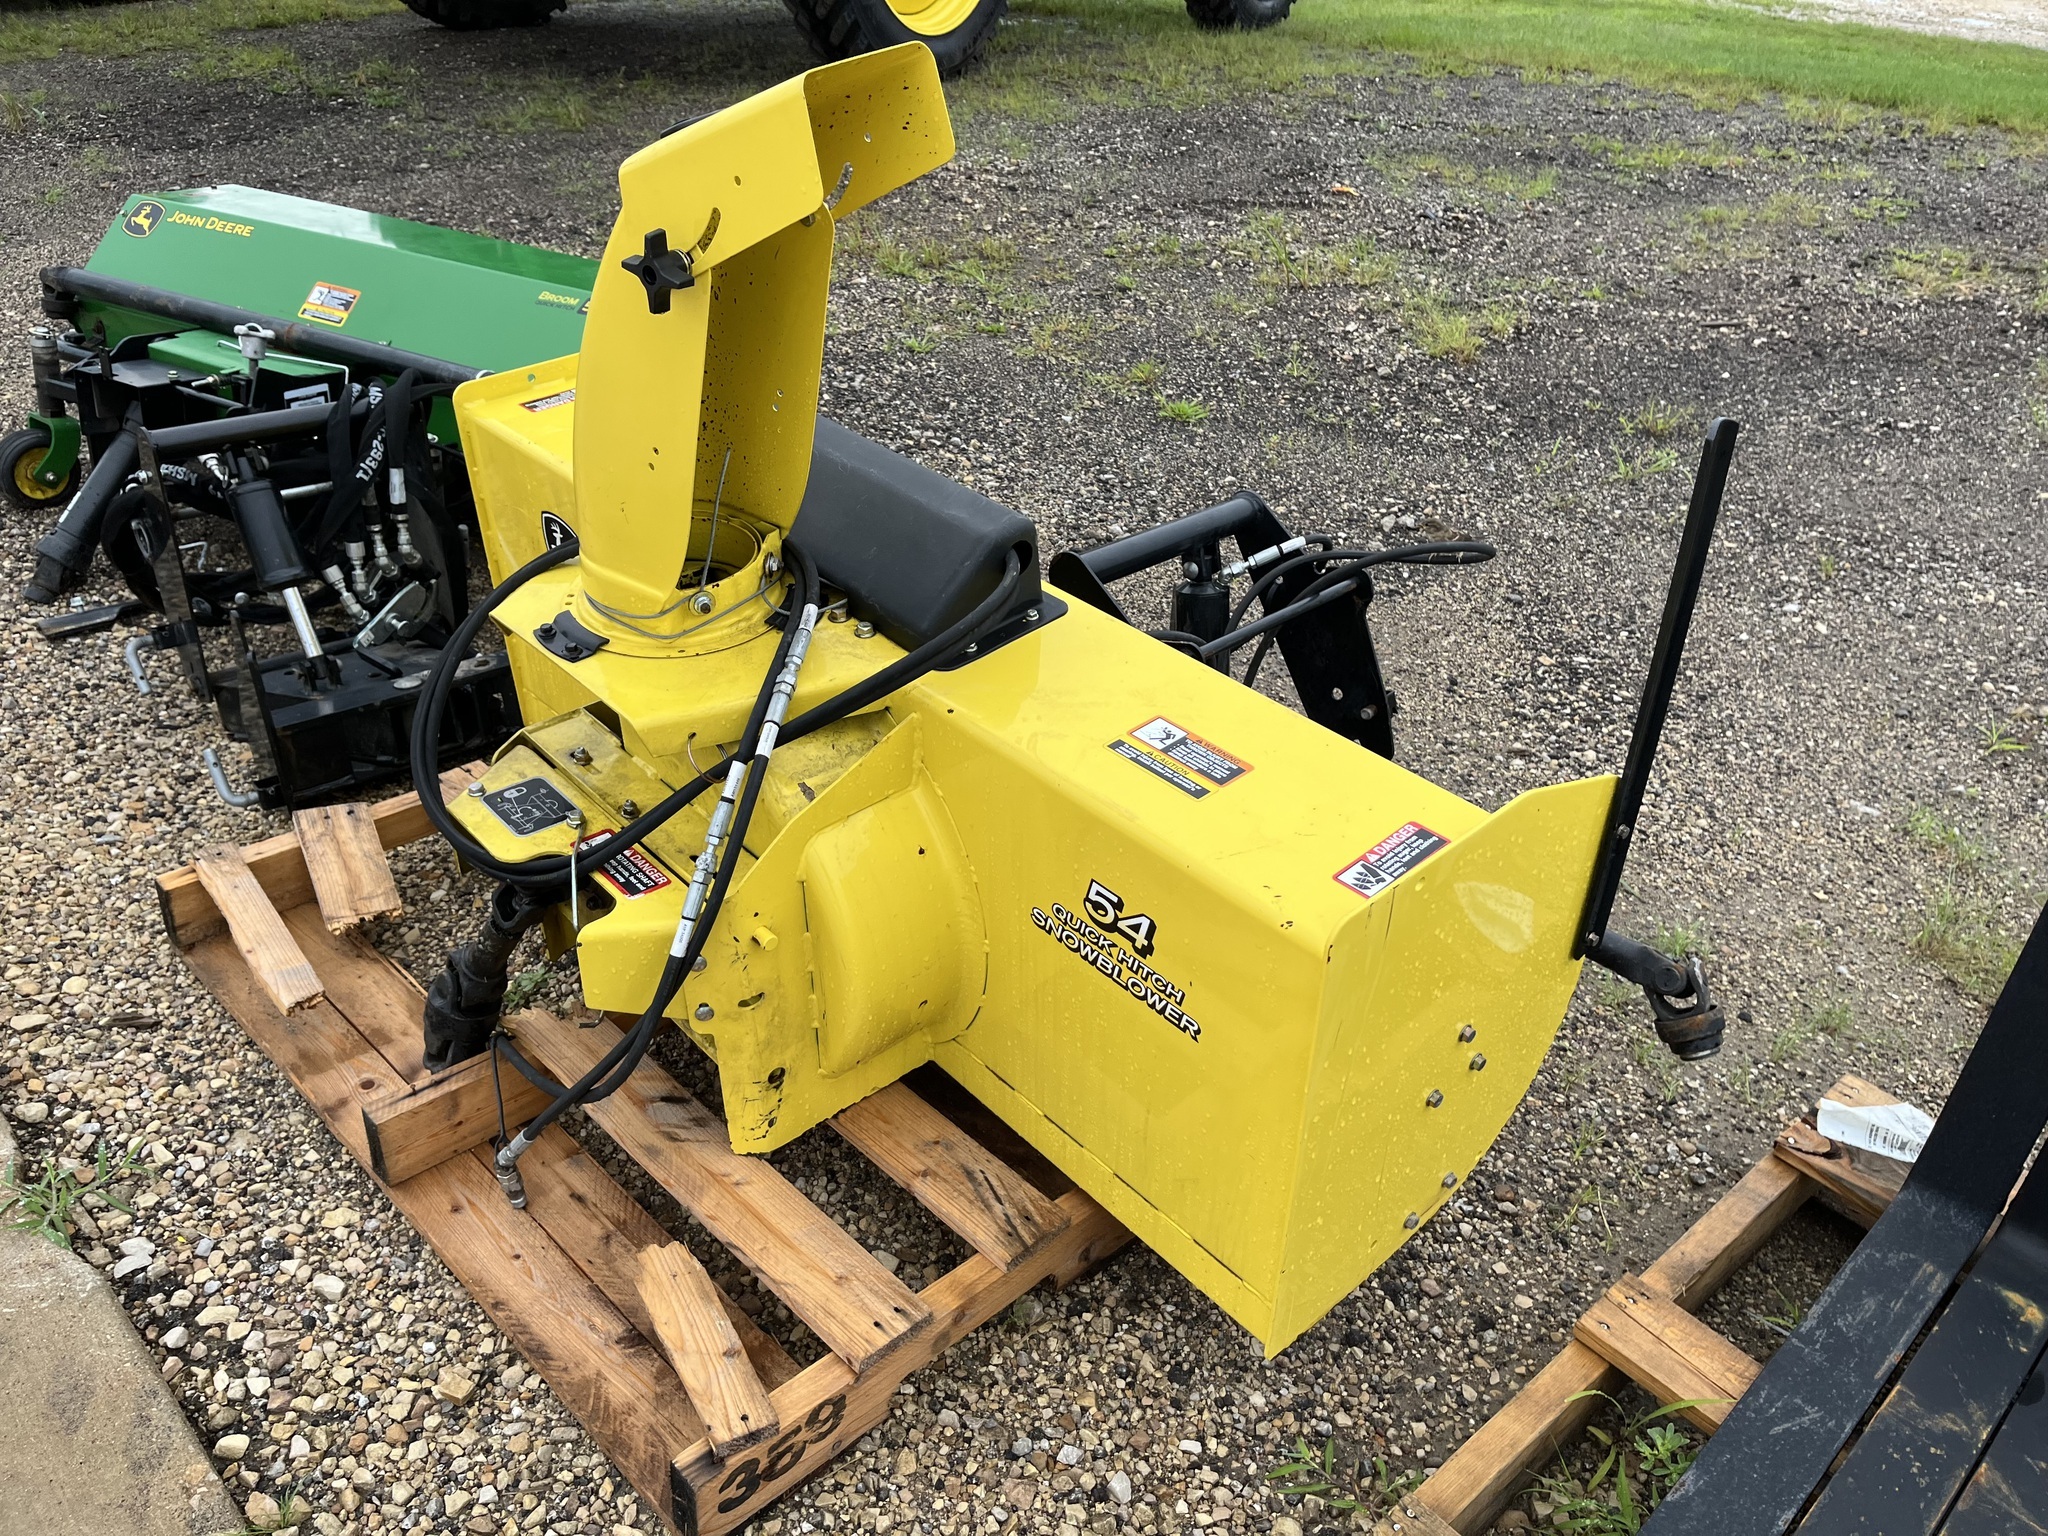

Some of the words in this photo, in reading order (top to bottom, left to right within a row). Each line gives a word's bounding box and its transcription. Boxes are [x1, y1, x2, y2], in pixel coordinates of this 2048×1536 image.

[167, 210, 206, 228] JOHN
[205, 217, 254, 237] DEERE
[538, 290, 580, 305] BROOM
[1154, 754, 1190, 776] CAUTION
[1204, 743, 1240, 764] WARNING
[1375, 823, 1419, 856] DANGER
[630, 853, 668, 884] DANGER
[636, 873, 655, 886] SHAFT
[1083, 878, 1157, 960] 54
[1052, 903, 1119, 958] QUICK
[1117, 948, 1186, 1007] HITCH
[1031, 907, 1202, 1043] SNOWBLOWER
